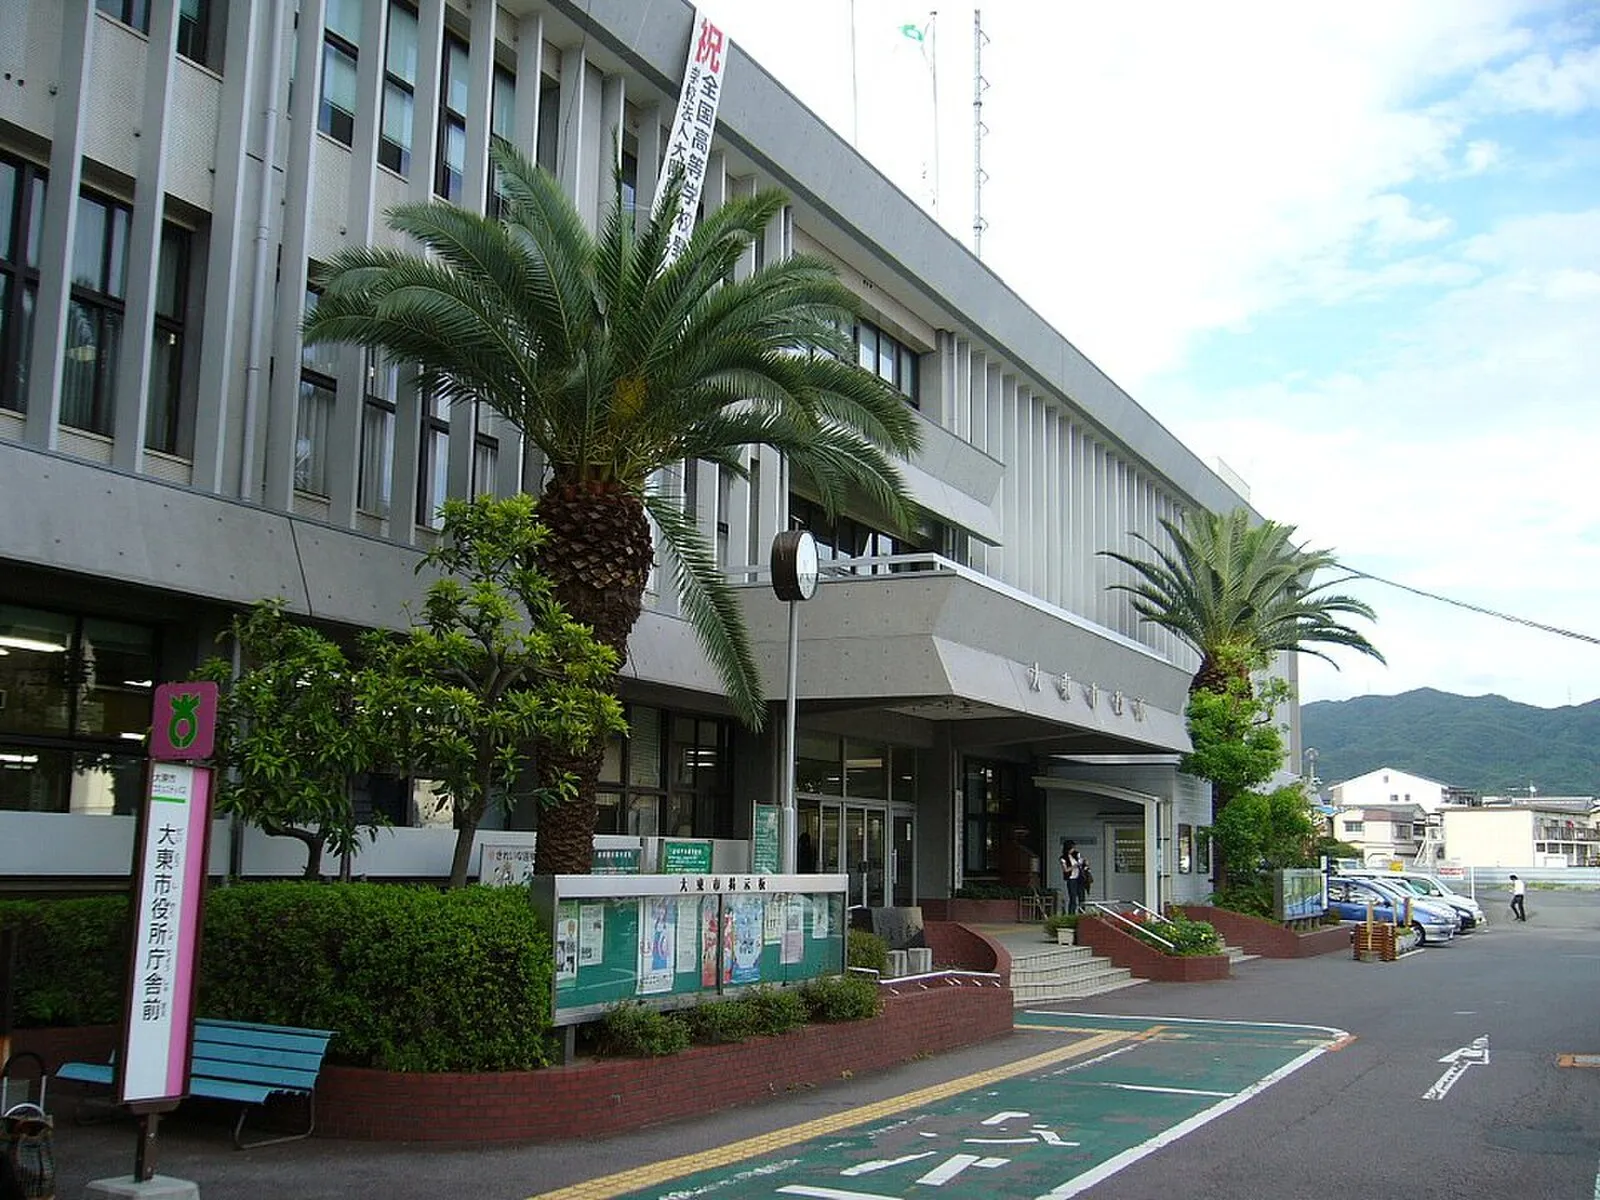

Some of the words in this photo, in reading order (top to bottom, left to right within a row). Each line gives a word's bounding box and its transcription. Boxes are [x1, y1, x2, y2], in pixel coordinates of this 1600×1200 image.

[695, 17, 724, 73] 祝
[680, 877, 766, 892] 大東市掲示板
[143, 823, 176, 1020] 大東市役所庁舎前
